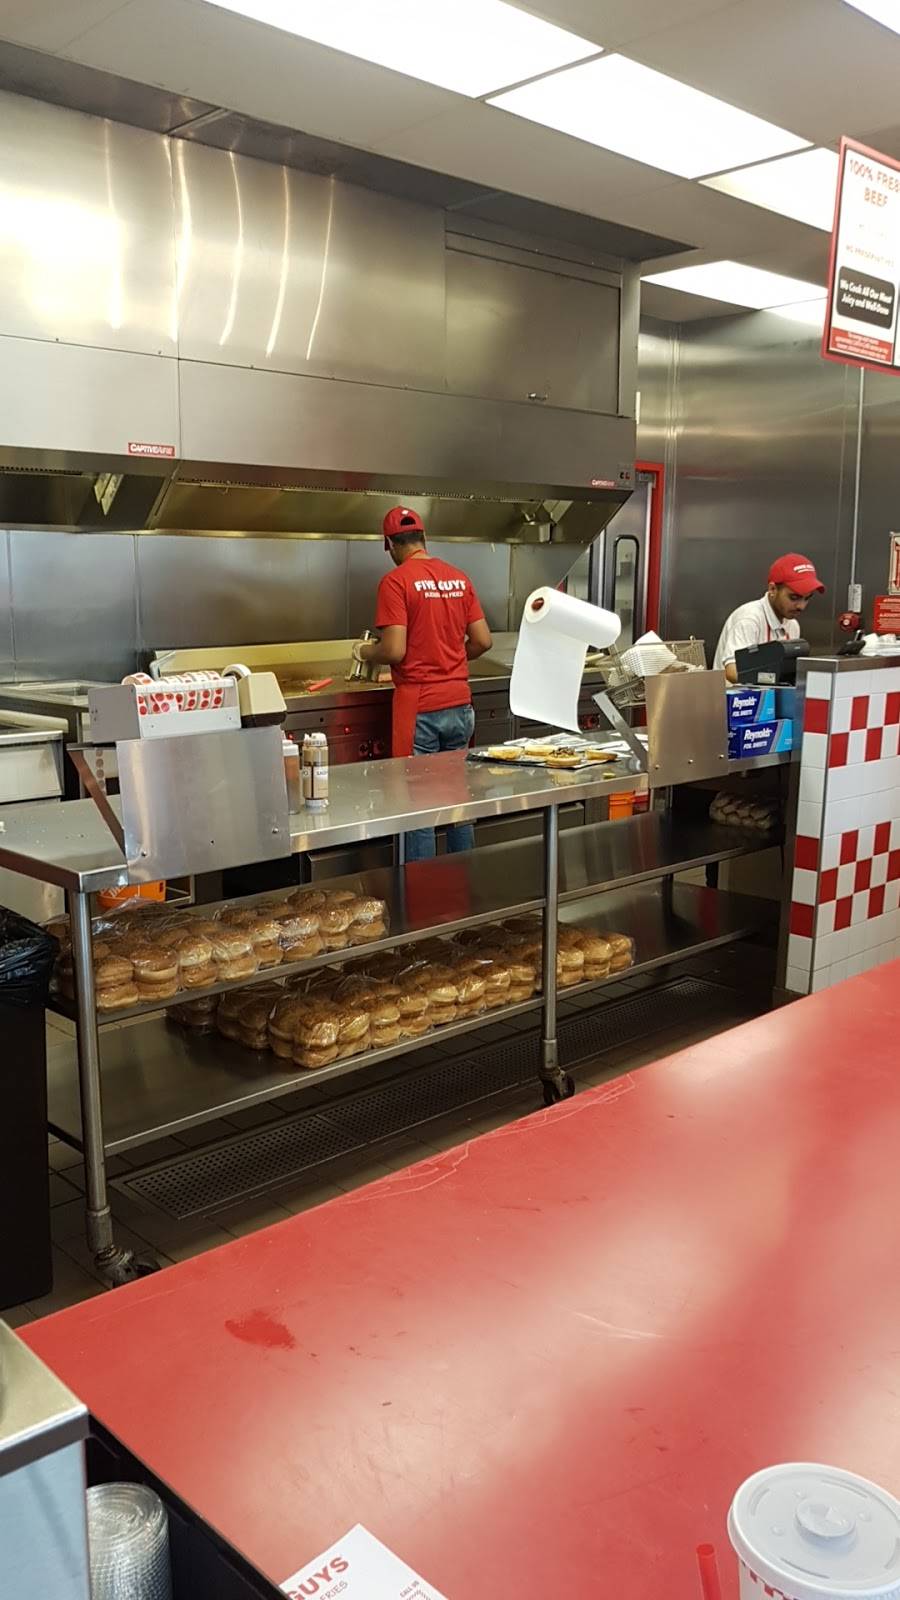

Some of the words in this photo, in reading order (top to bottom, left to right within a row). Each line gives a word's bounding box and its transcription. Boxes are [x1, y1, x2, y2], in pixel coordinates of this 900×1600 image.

[850, 159, 873, 181] 100%
[877, 171, 900, 192] FRES
[864, 187, 888, 207] BEEF
[414, 579, 437, 591] FIVE
[732, 696, 757, 709] Reynolds
[744, 727, 772, 742] Reynolds
[287, 1556, 349, 1600] GUYS
[320, 1580, 348, 1600] FRIES
